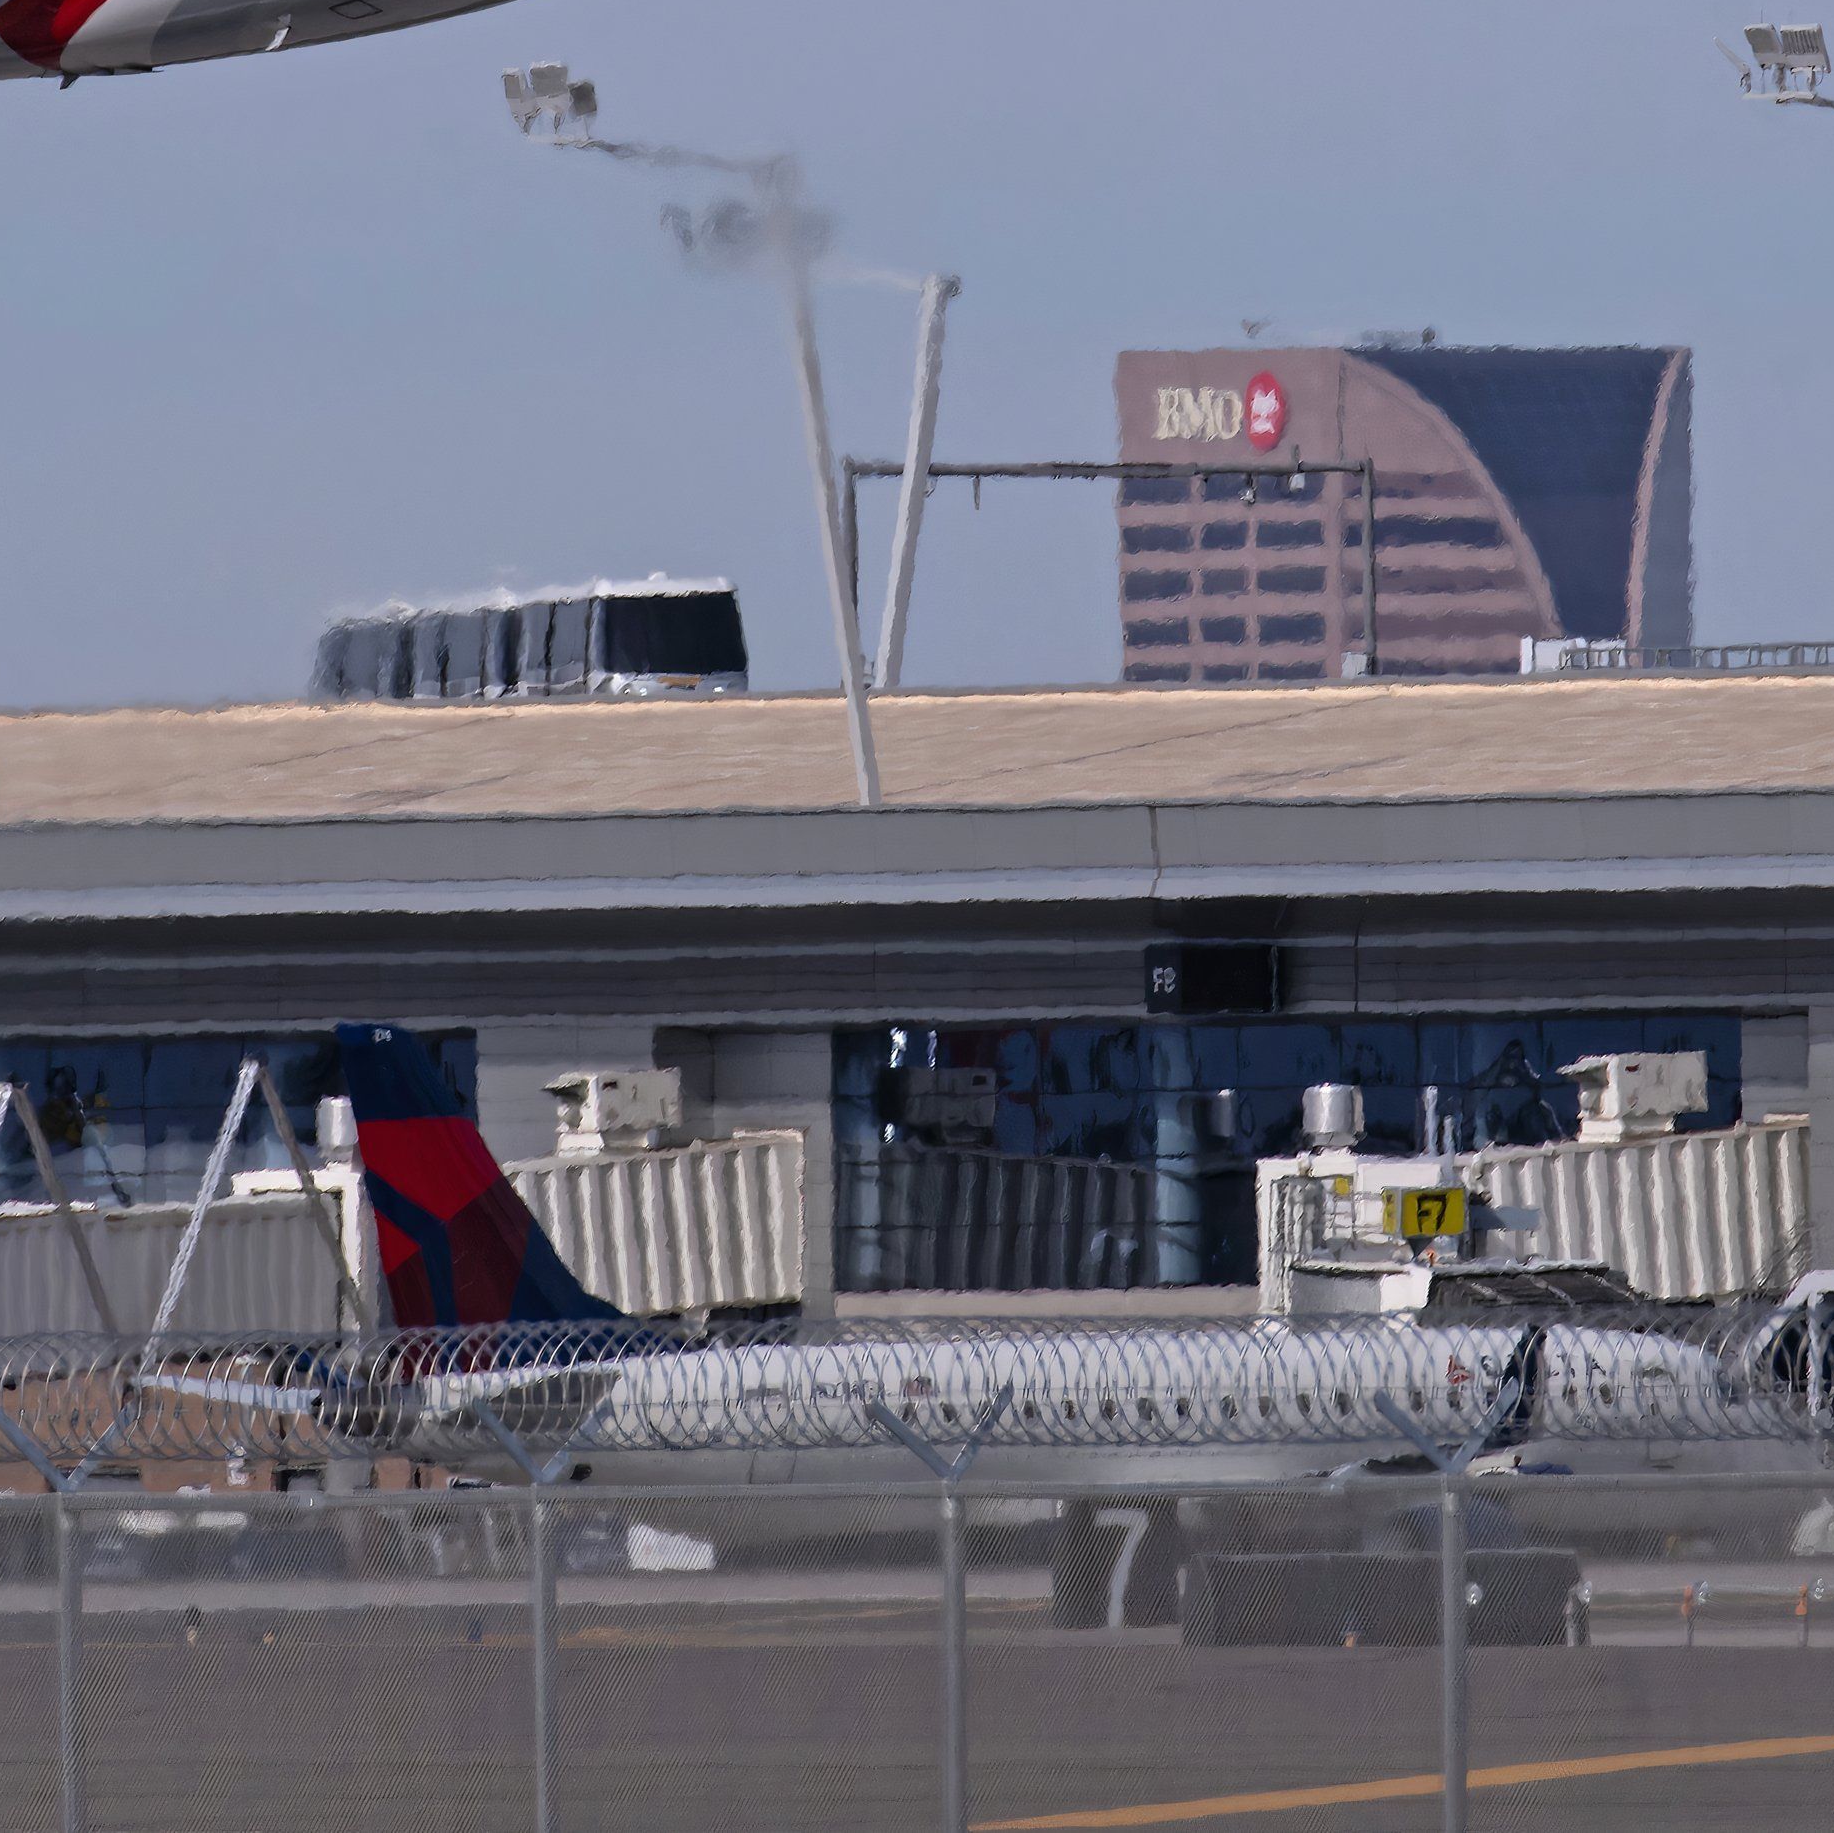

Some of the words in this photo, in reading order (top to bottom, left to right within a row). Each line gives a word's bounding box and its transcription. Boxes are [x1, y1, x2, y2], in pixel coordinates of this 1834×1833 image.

[1151, 386, 1245, 442] BMO
[1417, 1193, 1448, 1233] F7
[1093, 1507, 1149, 1628] 7
